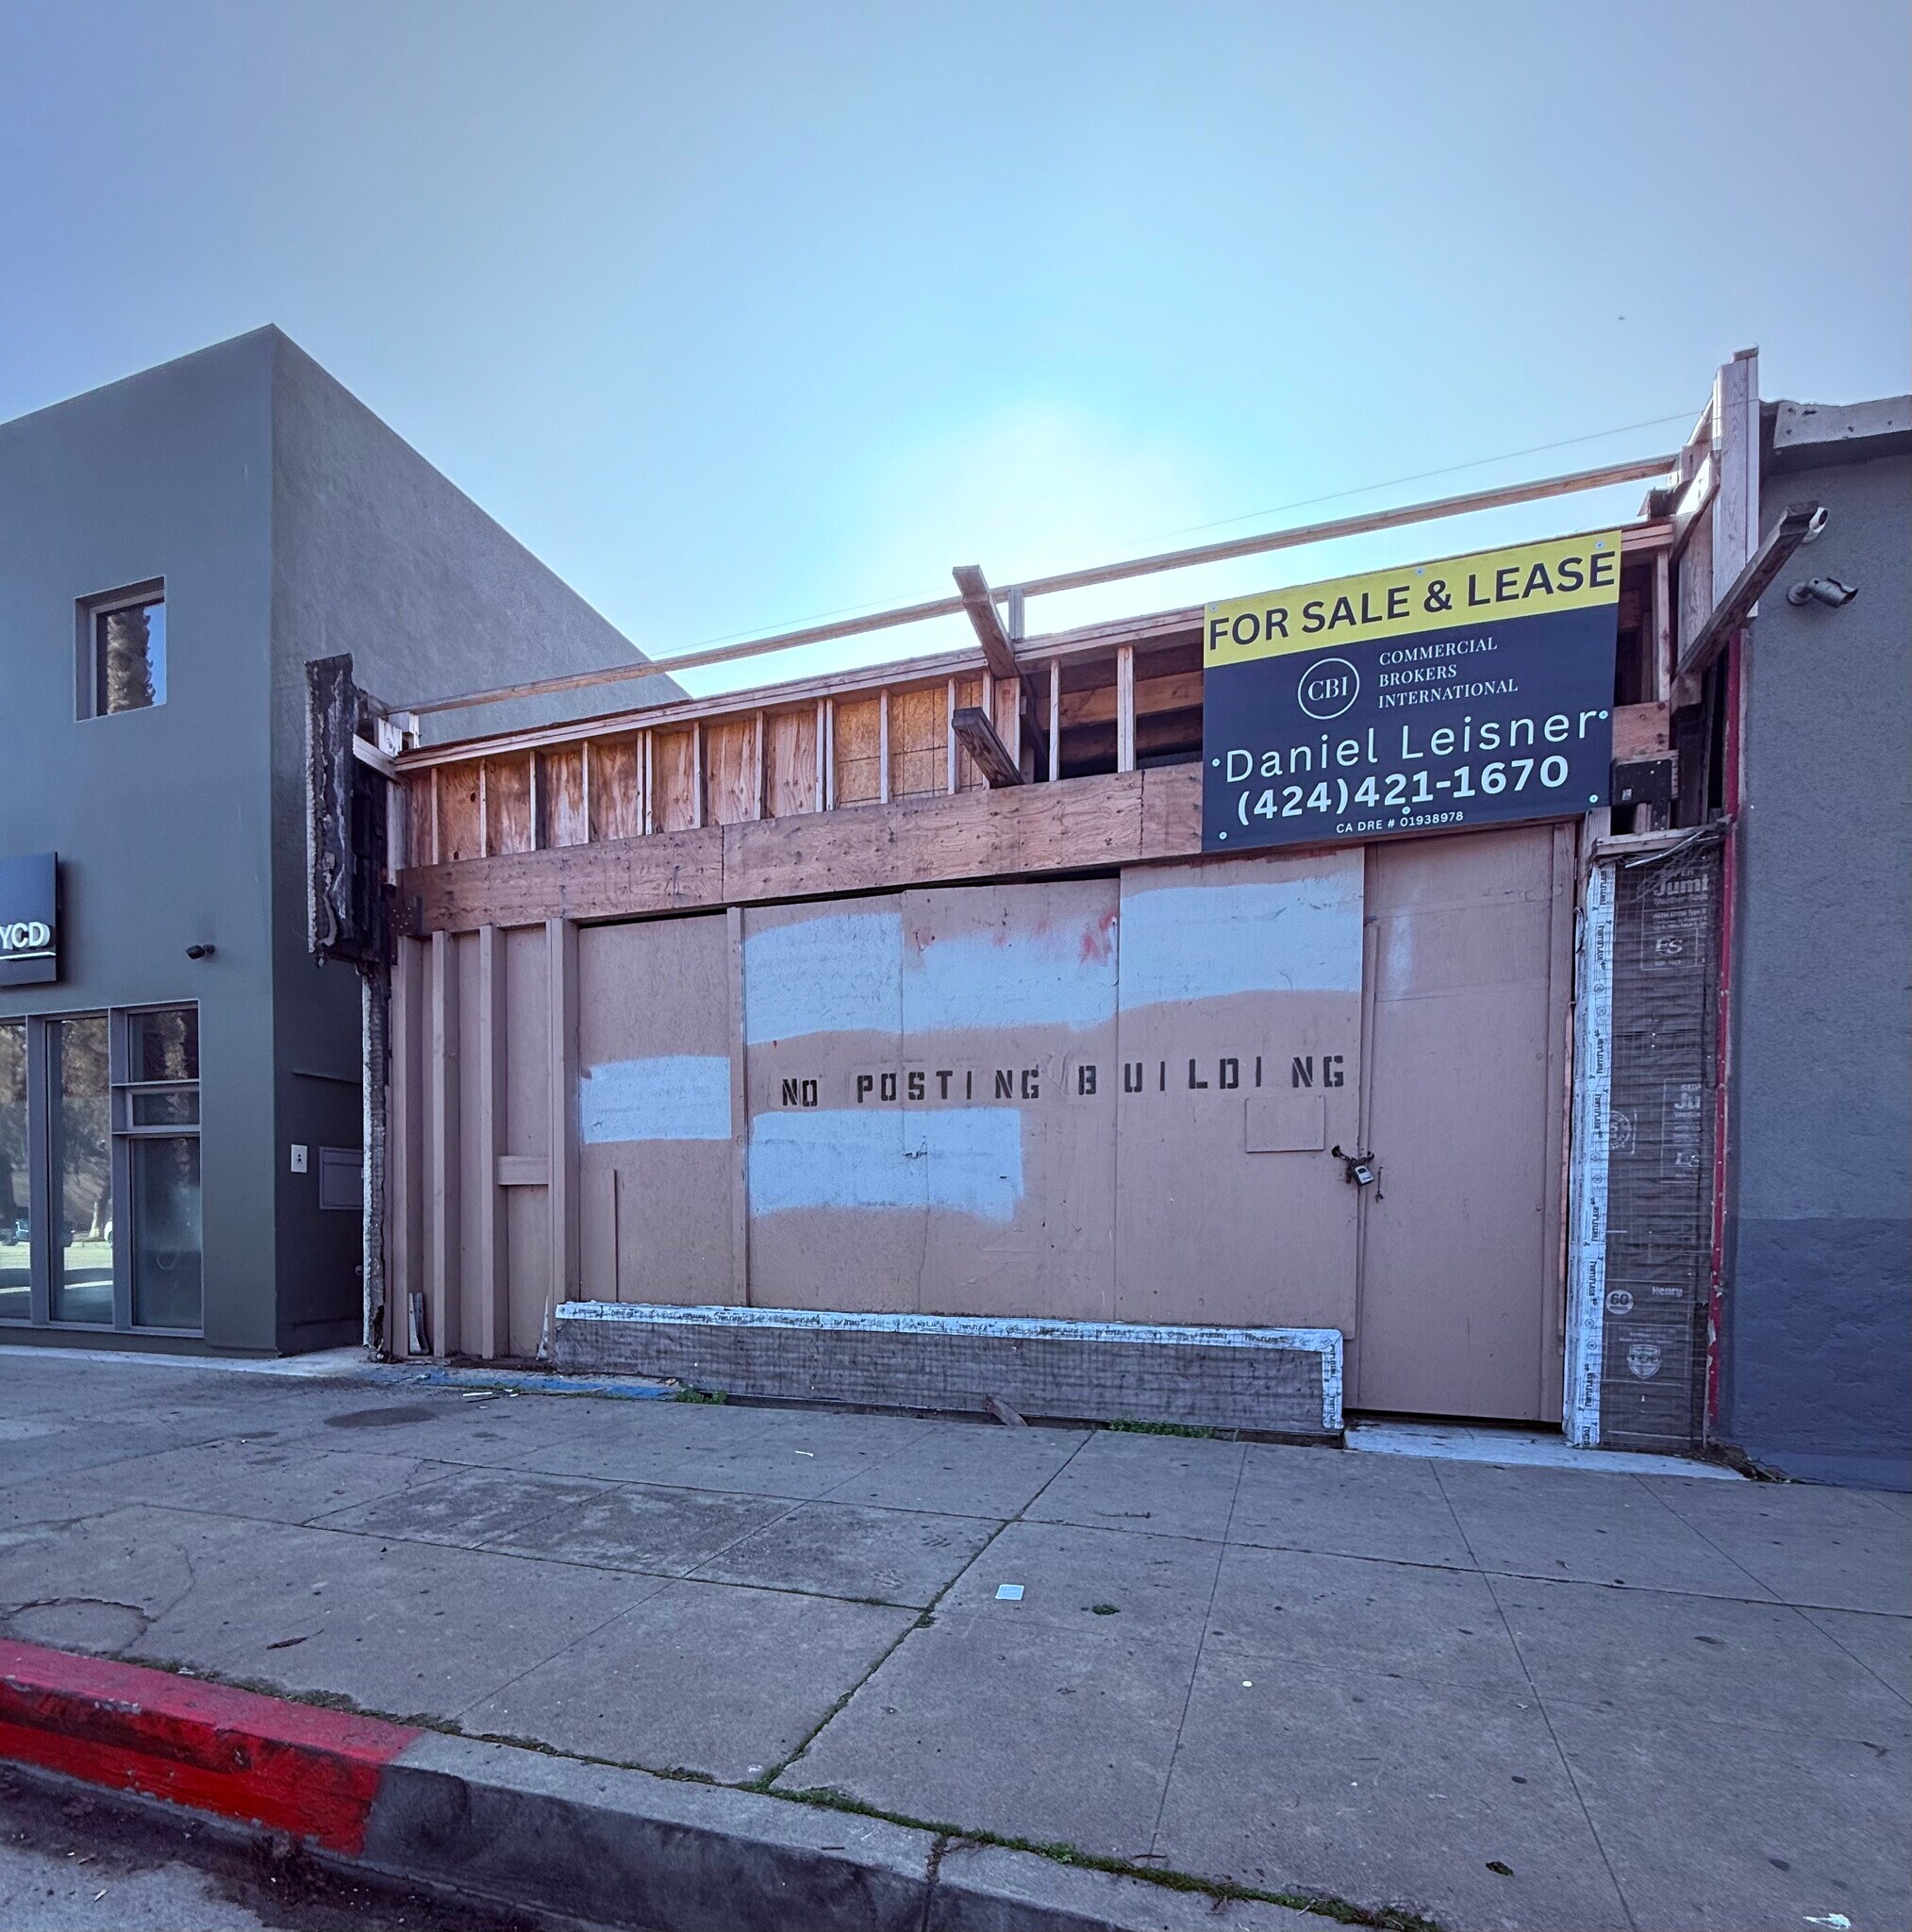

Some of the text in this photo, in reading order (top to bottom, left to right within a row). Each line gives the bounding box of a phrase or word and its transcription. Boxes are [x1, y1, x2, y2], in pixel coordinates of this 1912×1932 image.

[1209, 550, 1616, 651] FOR SALE & LEASE
[1379, 637, 1498, 666] COMMERCIAL
[1307, 675, 1349, 701] CBI
[1378, 663, 1457, 688] BROKERS
[1378, 678, 1519, 708] INTERNATIONAL
[1226, 710, 1598, 783] Daniel Leisner
[1237, 755, 1569, 826] (424)421-1670
[1336, 810, 1465, 834] CA DRE # 01938978
[781, 1077, 819, 1108] NO
[856, 1069, 1039, 1104] POSTING
